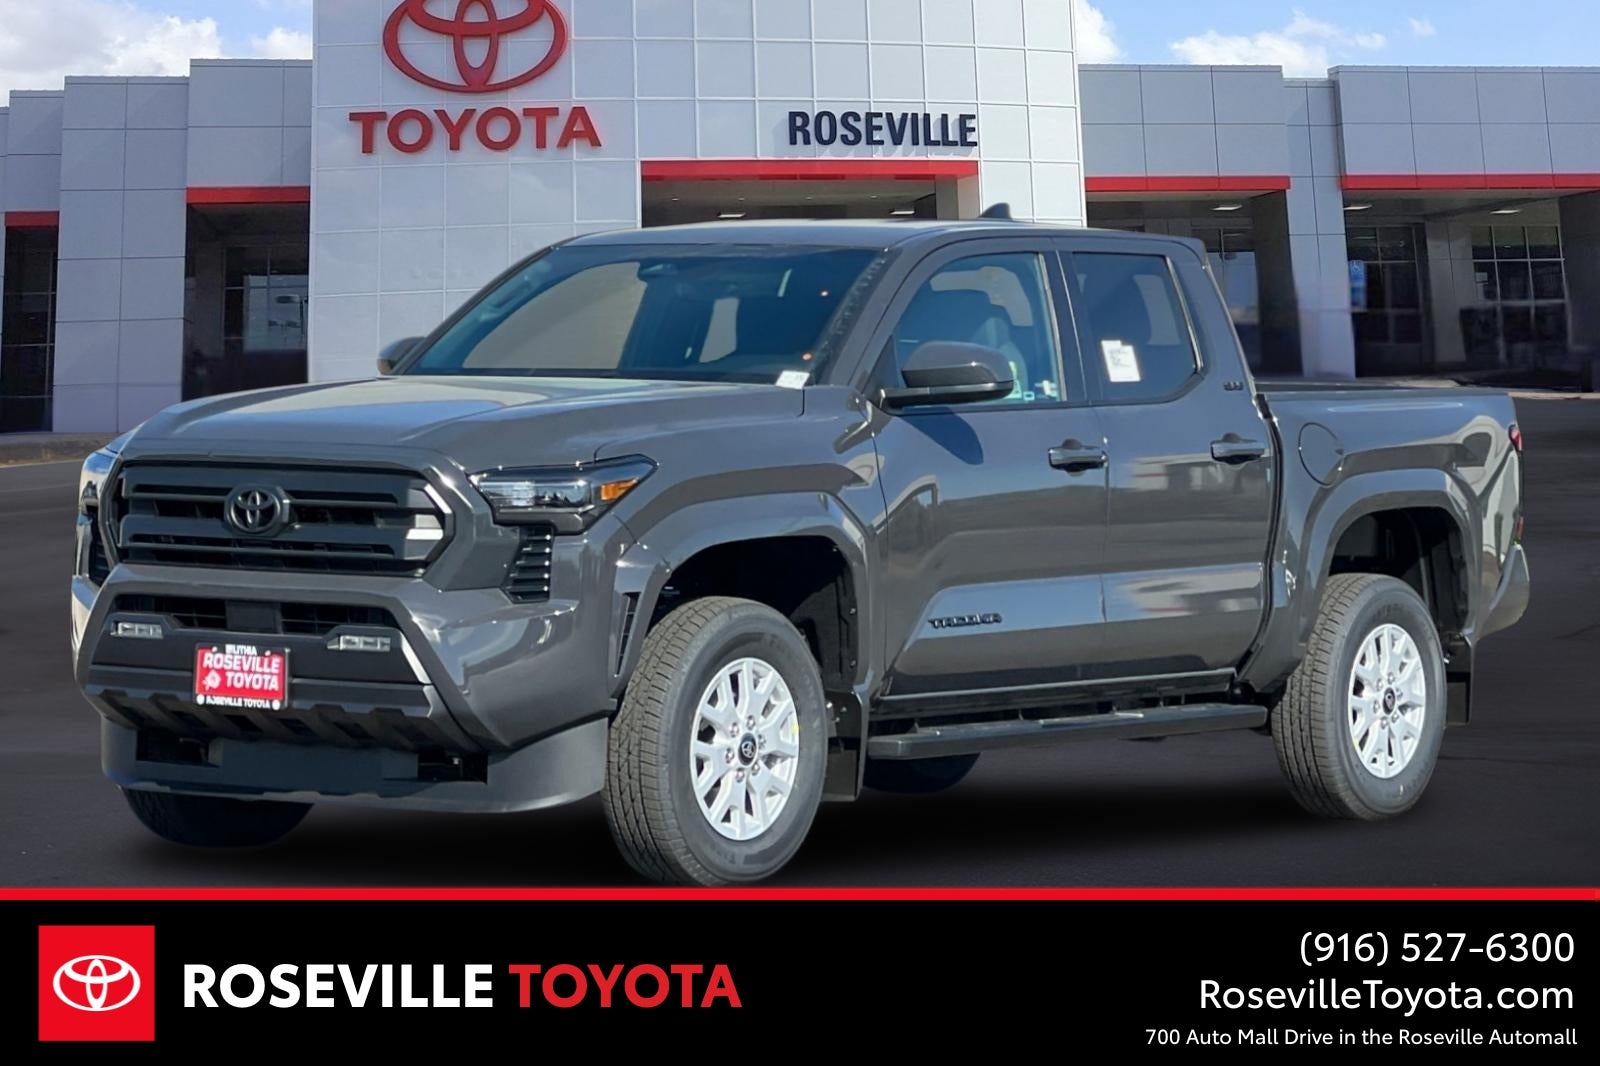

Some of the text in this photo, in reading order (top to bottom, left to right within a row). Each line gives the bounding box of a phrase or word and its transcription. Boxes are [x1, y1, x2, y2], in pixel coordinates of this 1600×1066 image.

[349, 106, 602, 154] TOYOTA
[787, 110, 978, 147] ROSEVILLE
[202, 652, 281, 674] ROSEVILLE
[225, 671, 280, 692] TOYOTA
